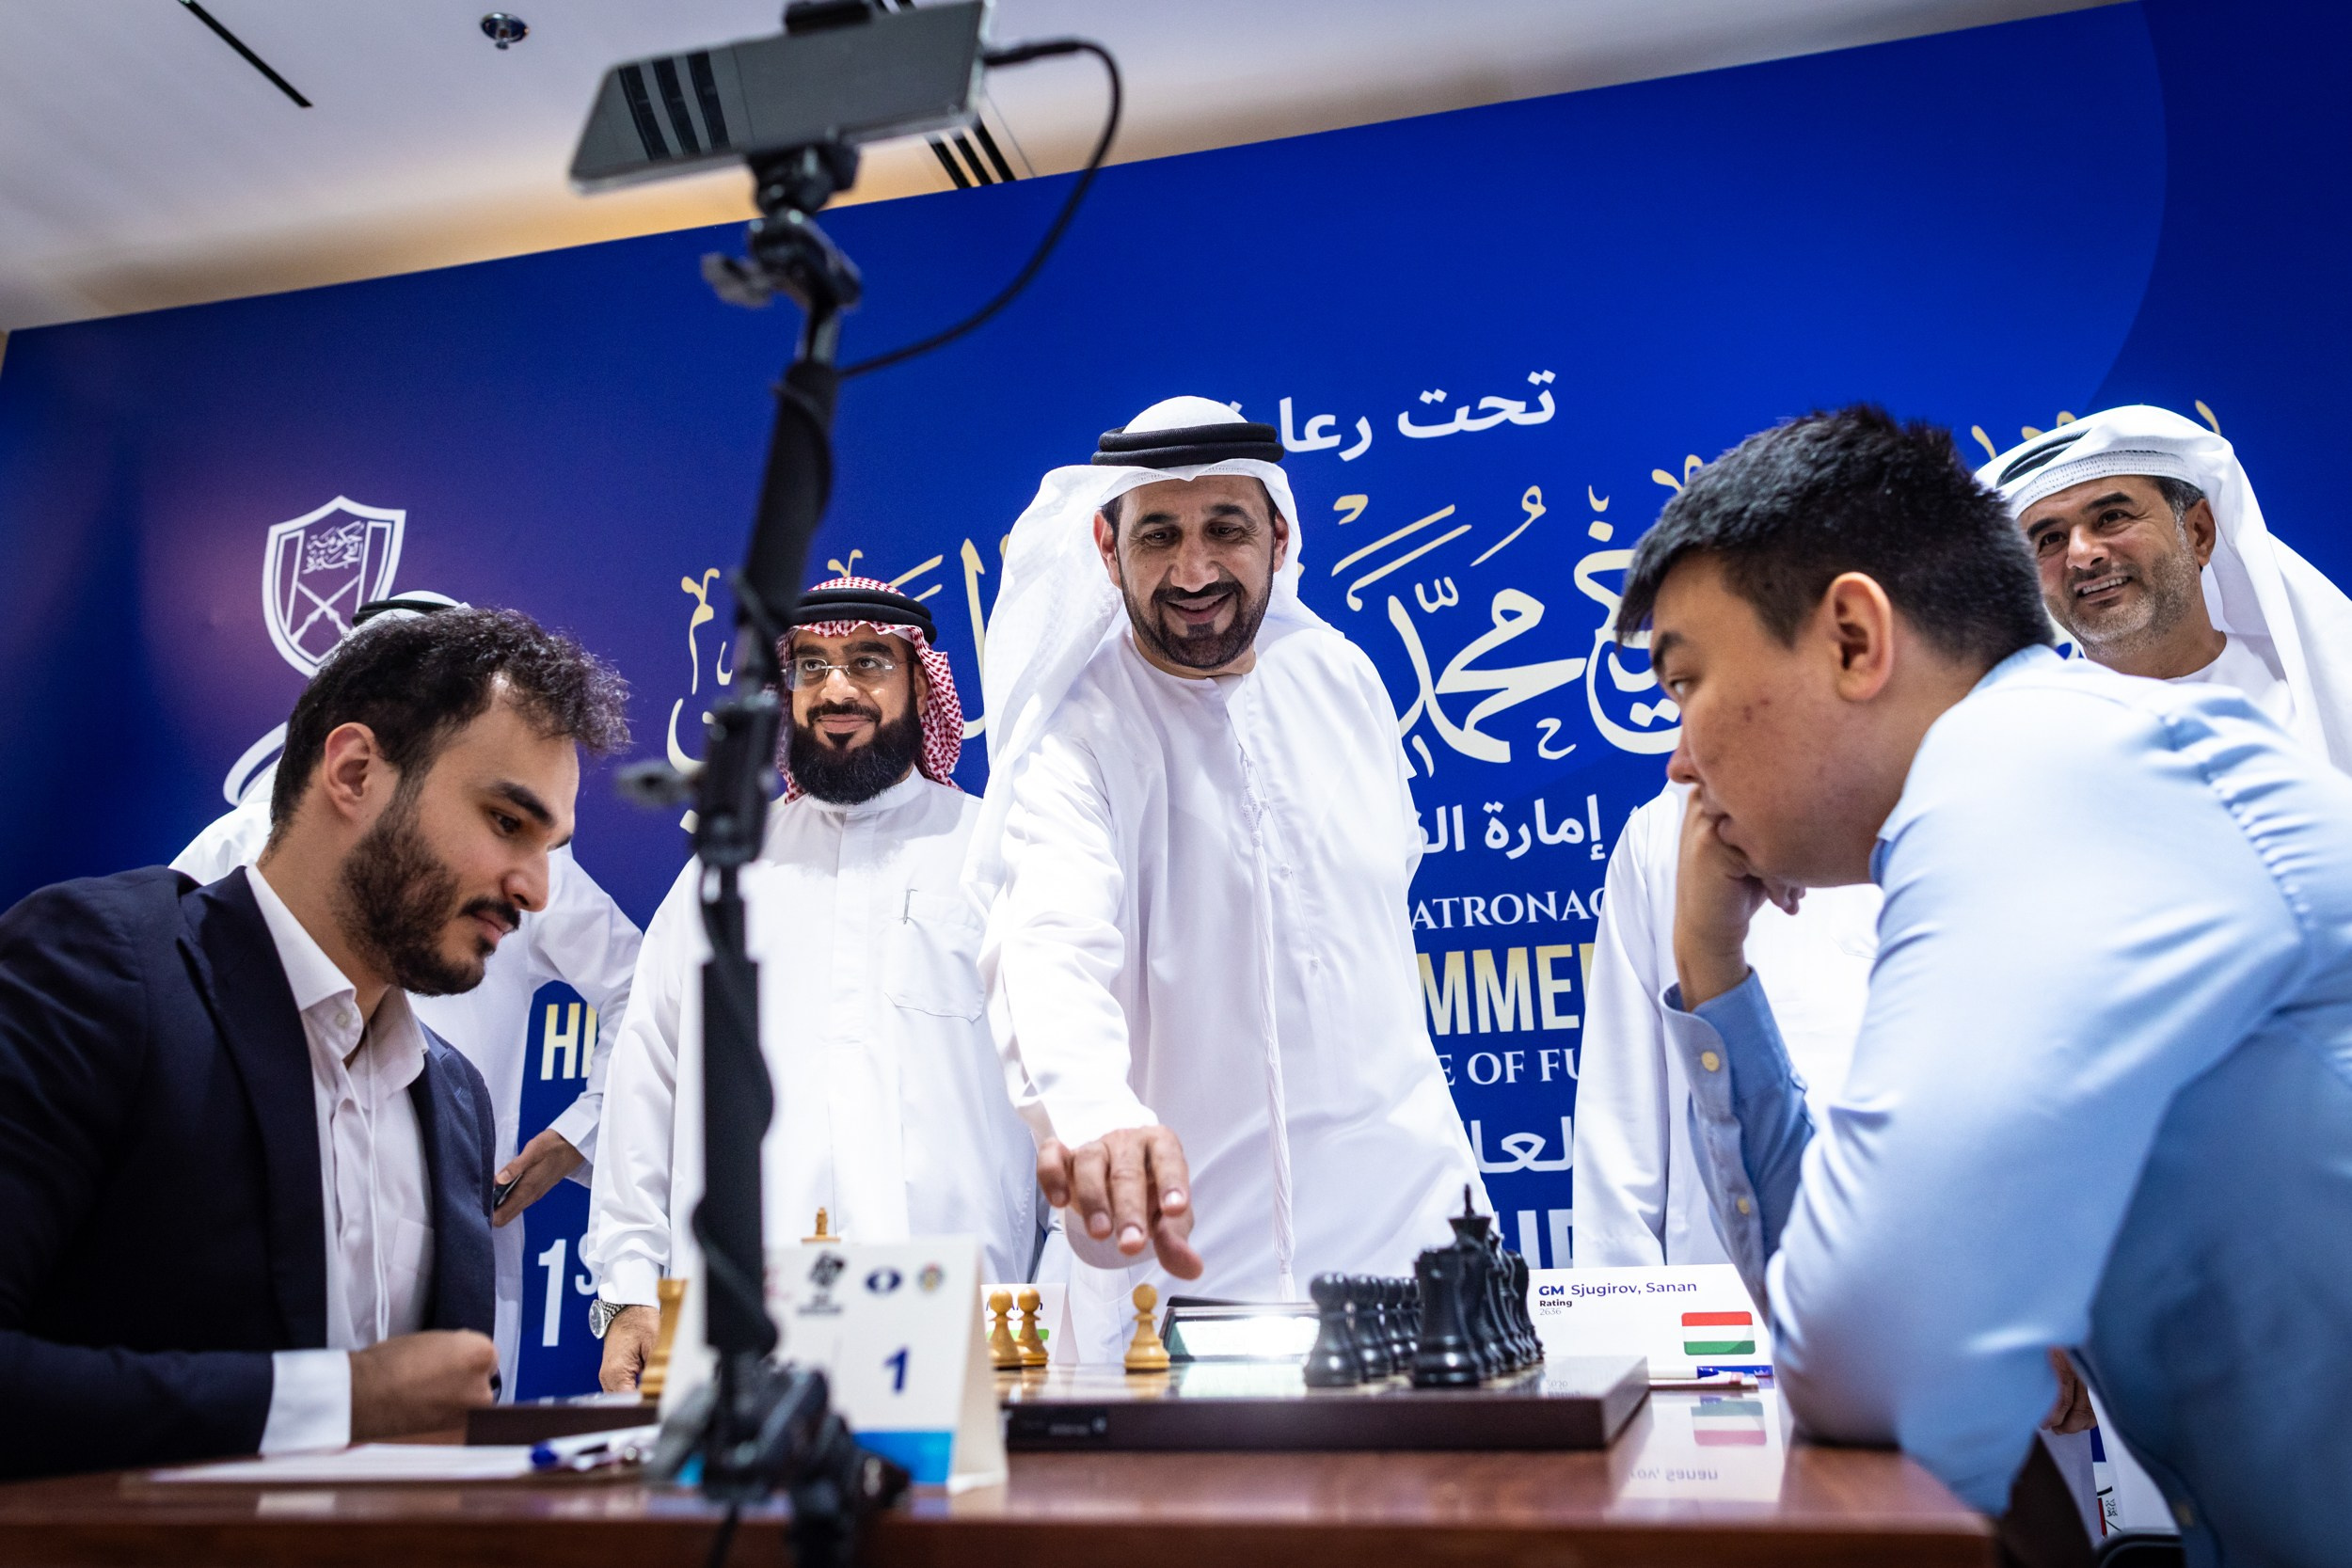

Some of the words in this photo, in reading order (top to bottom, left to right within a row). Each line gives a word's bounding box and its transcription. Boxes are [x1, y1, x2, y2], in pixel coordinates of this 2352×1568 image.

[1398, 369, 1556, 439] تحت
[1483, 794, 1606, 861] إمارة
[1407, 887, 1605, 930] ATRONA
[1467, 1051, 1525, 1085] OF
[1538, 1285, 1565, 1296] GM
[1571, 1282, 1643, 1298] Sjugirov,
[1645, 1282, 1697, 1294] Sanan
[1539, 1299, 1573, 1308] Rating
[1539, 1307, 1562, 1316] 2636
[882, 1344, 909, 1395] 1
